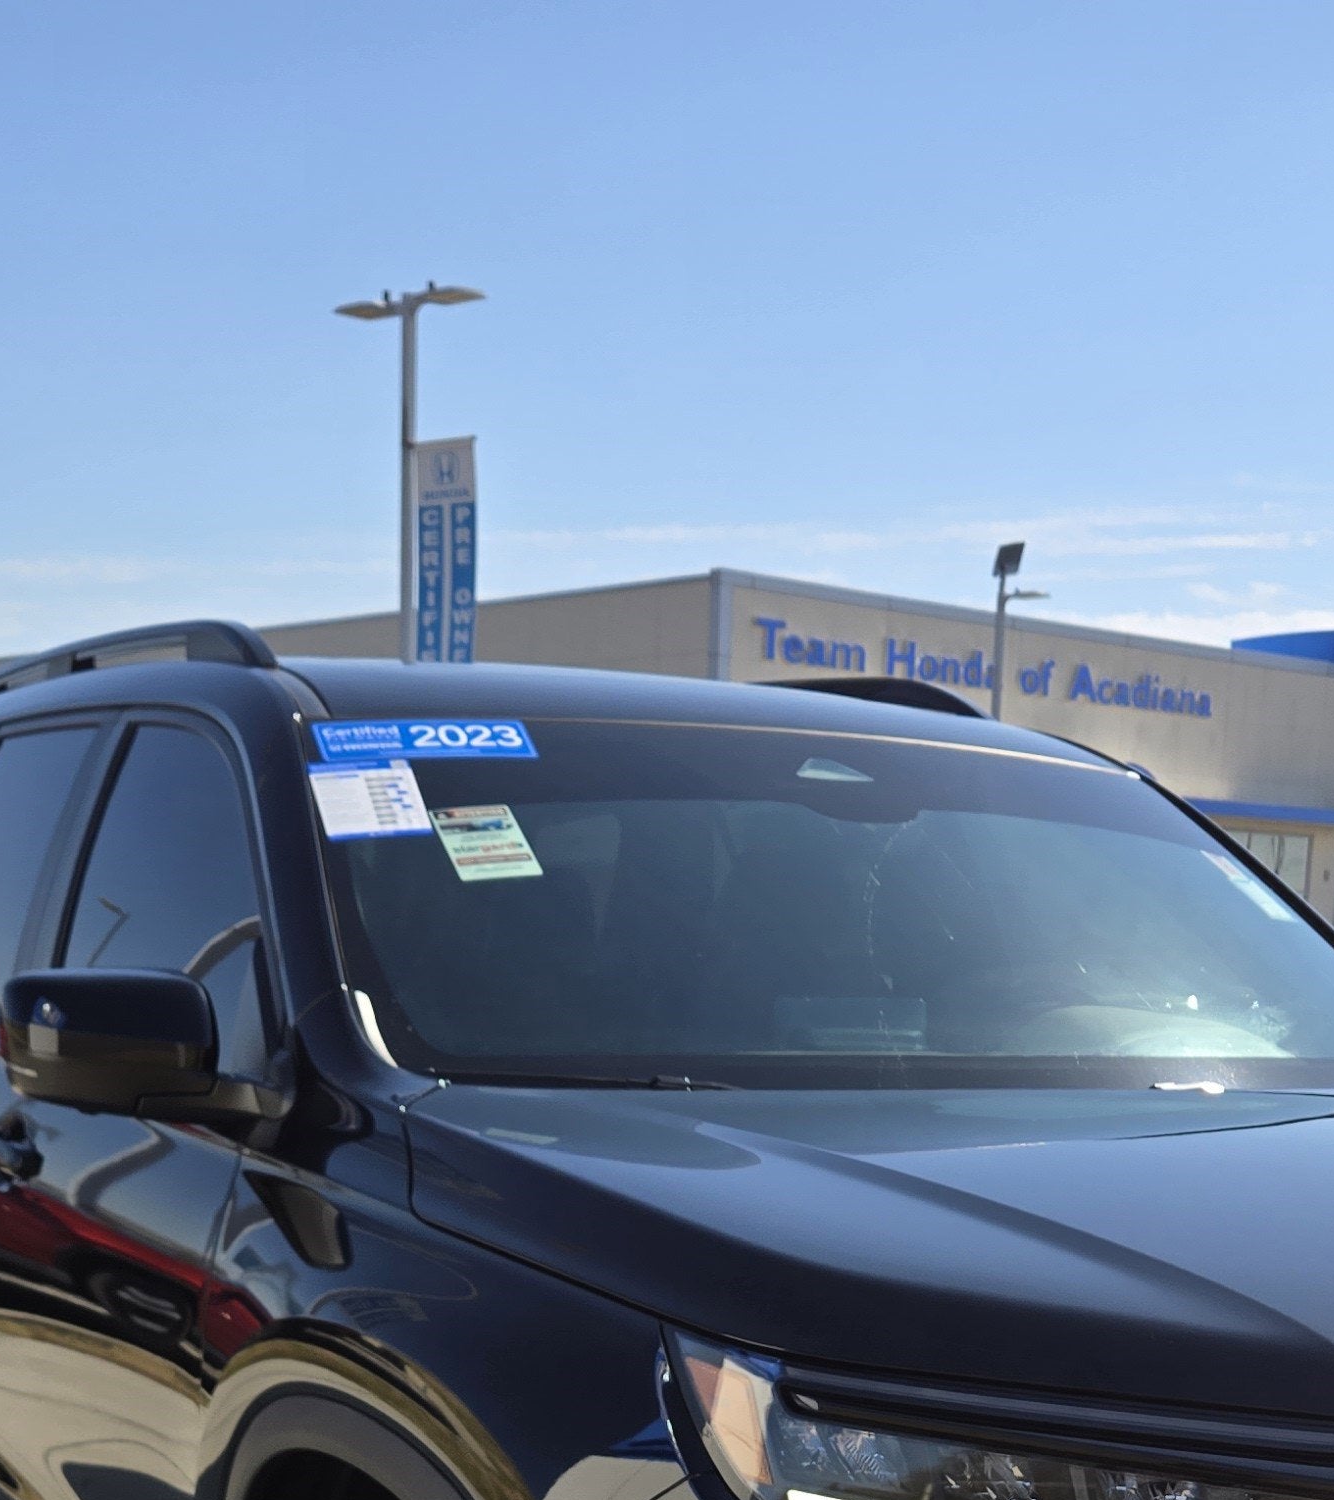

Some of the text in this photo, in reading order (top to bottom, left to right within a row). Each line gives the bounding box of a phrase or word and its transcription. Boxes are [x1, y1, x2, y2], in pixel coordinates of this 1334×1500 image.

[754, 617, 866, 674] Team
[1019, 660, 1057, 696] of
[1070, 664, 1213, 718] Acadiana
[408, 723, 523, 748] 2023
